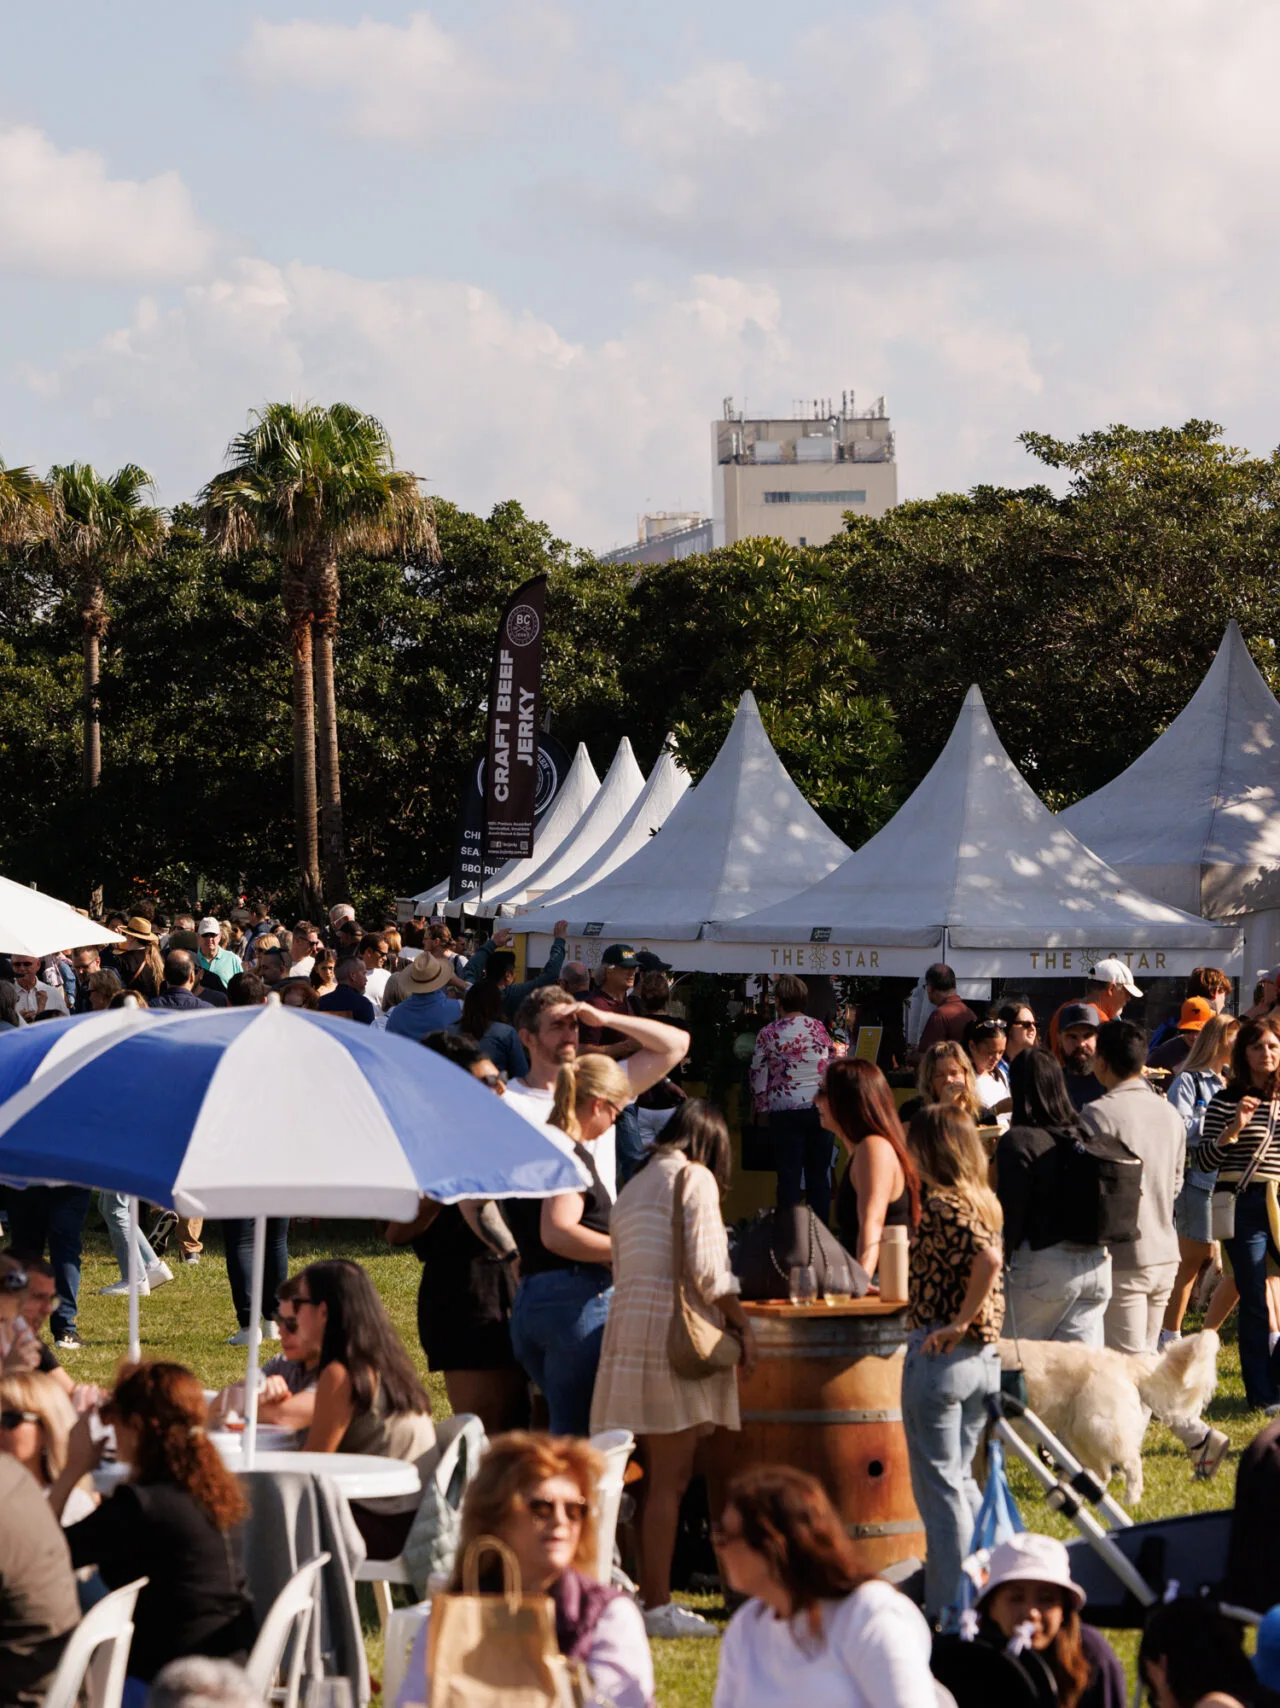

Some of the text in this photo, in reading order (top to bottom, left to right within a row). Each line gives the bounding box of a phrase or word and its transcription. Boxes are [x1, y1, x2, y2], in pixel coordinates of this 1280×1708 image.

[516, 614, 531, 625] BC
[494, 649, 514, 803] CRAFT BEEF
[516, 686, 536, 767] JERKY
[770, 948, 880, 968] THE STAR
[1030, 952, 1072, 969] THE
